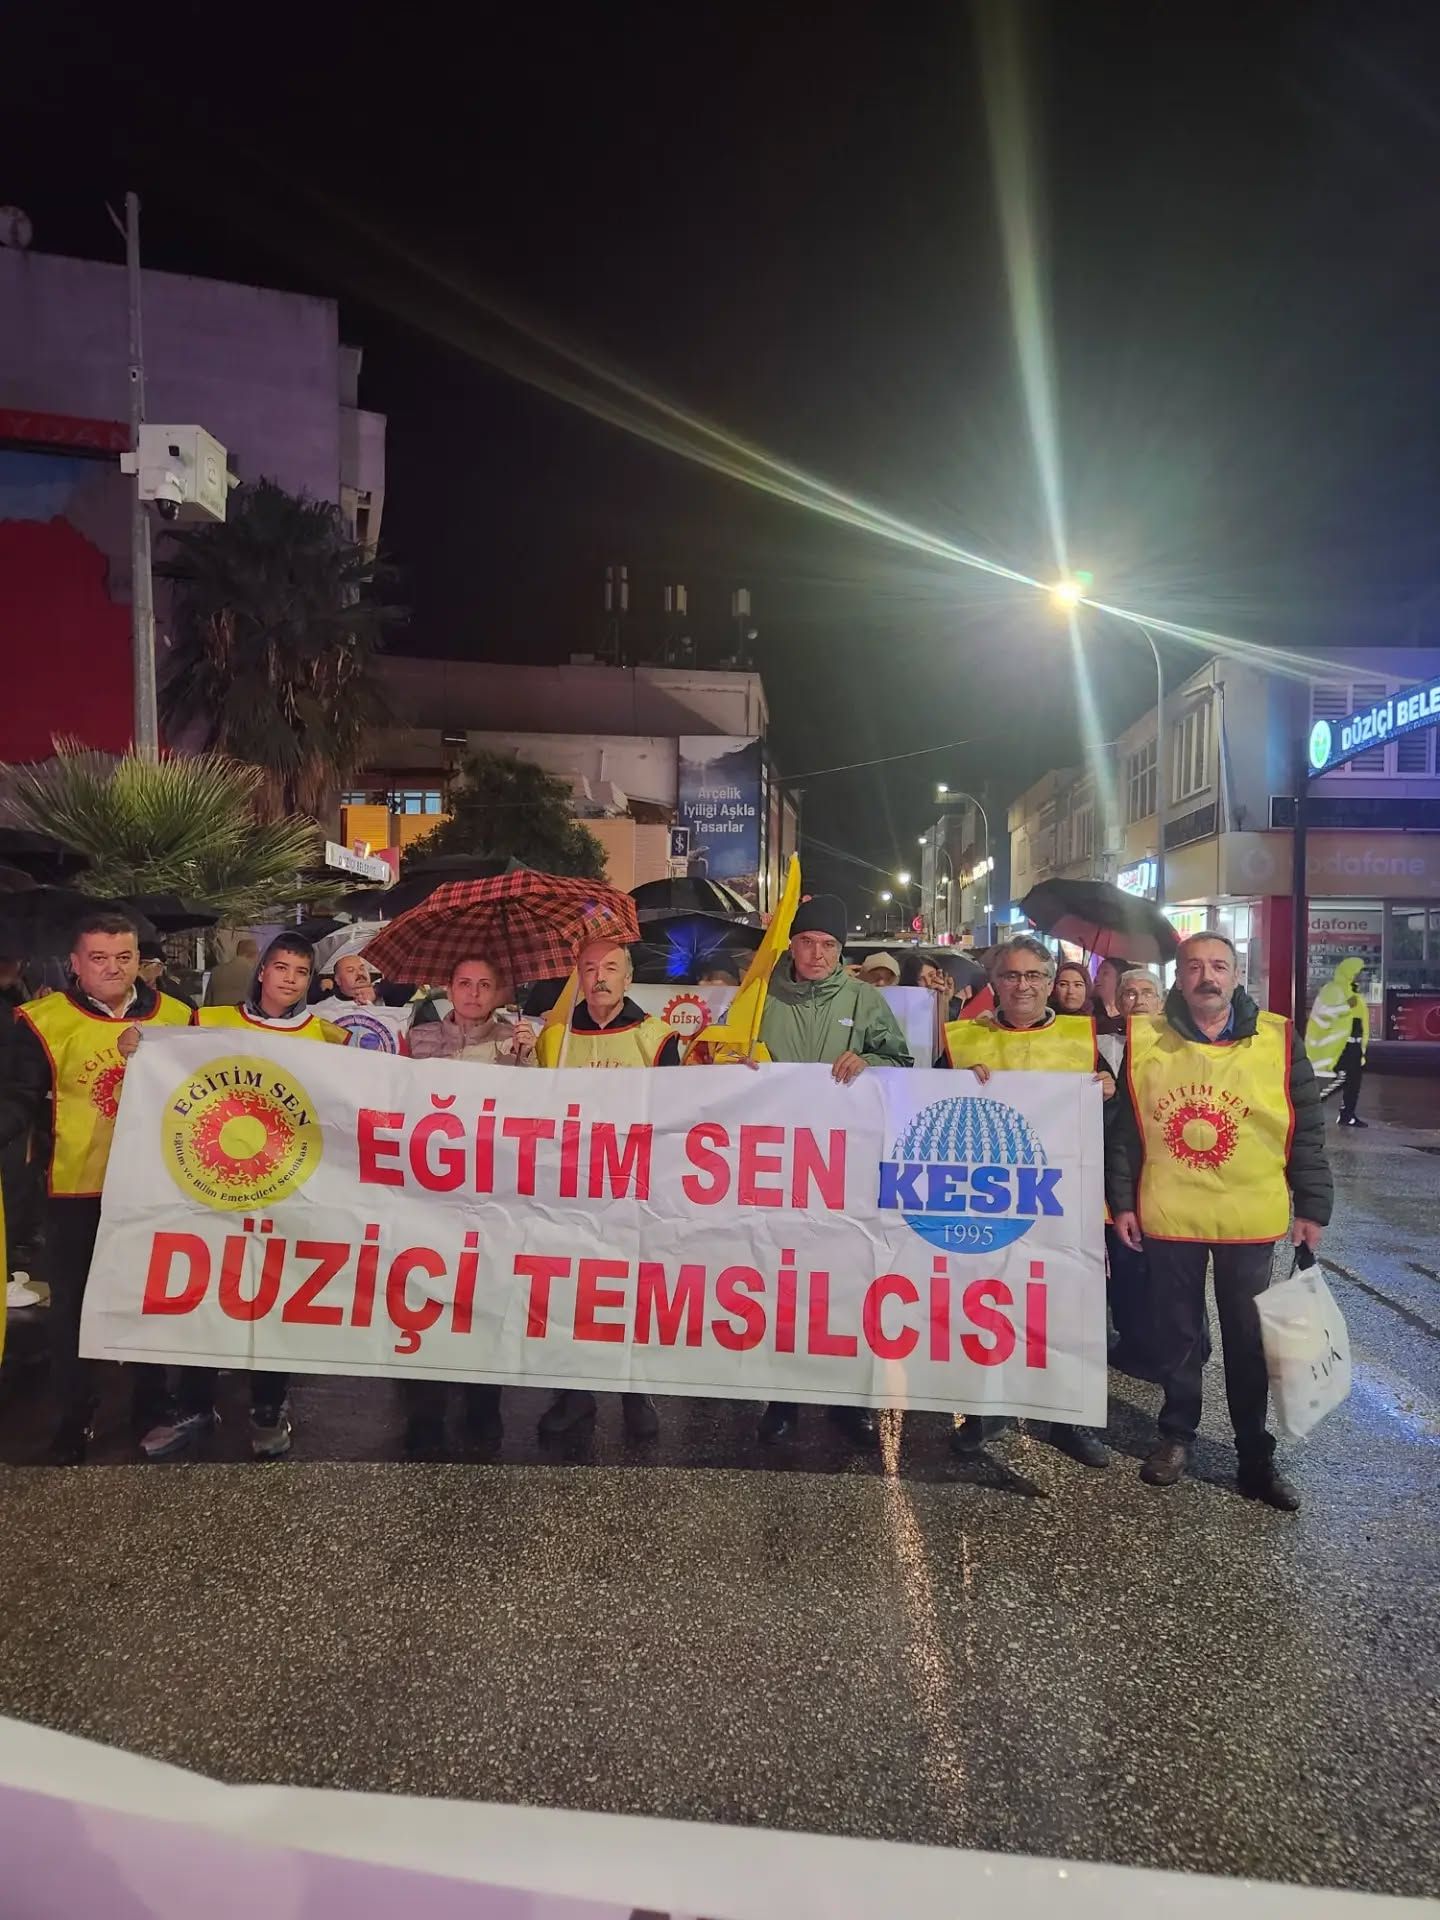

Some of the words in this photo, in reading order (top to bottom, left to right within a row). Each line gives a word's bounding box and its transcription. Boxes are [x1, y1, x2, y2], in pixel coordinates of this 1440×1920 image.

[1341, 700, 1393, 751] DÜZİÇİ
[683, 800, 717, 819] İyiliği
[719, 803, 755, 820] Aşkla
[697, 785, 742, 802] Arçelik
[693, 820, 744, 833] Tasarlar
[1290, 848, 1425, 876] odafone
[672, 1011, 701, 1025] DİSK
[77, 1048, 115, 1084] EĞİT
[173, 1065, 263, 1117] EĞİTİM
[269, 1082, 312, 1127] SEN
[1152, 1081, 1214, 1122] EĞİTİM
[1217, 1089, 1255, 1119] SEN
[357, 1093, 654, 1201] EĞİTİM
[681, 1122, 847, 1210] SEN
[183, 1168, 193, 1180] ve
[193, 1179, 218, 1198] Bilim
[220, 1184, 278, 1203] Emekçileri
[277, 1141, 308, 1186] Sendikası
[877, 1161, 1064, 1217] KESK
[943, 1224, 994, 1247] 1995
[142, 1218, 480, 1354] DÜZİÇİ
[514, 1248, 1048, 1369] TEMSİLCİSİ
